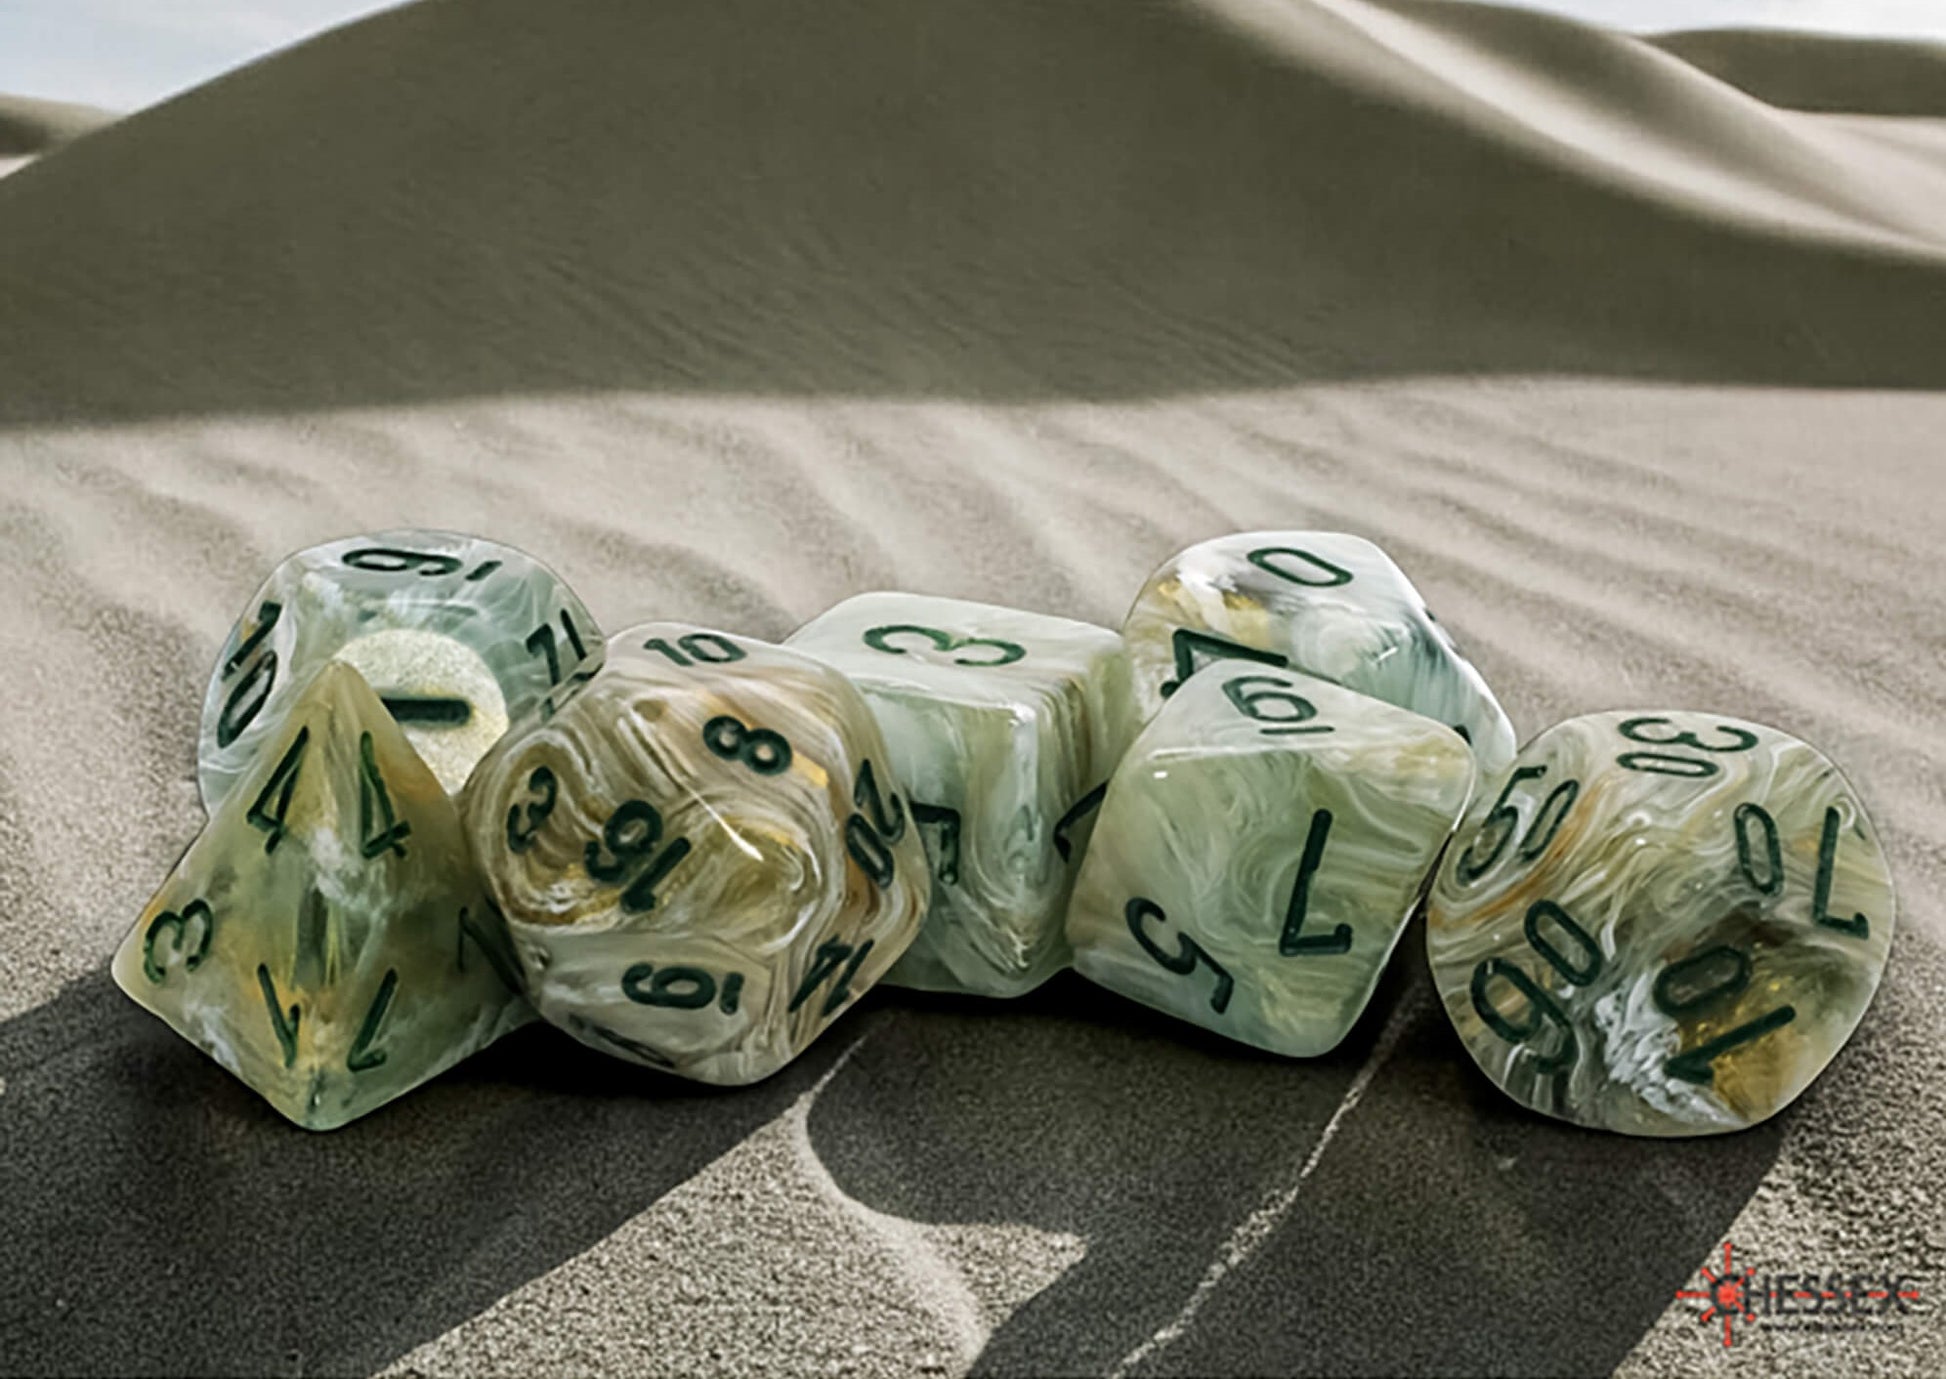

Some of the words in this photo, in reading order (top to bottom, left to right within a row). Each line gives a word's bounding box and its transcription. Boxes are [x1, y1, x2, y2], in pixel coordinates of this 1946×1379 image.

[1246, 546, 1354, 588] 0
[643, 632, 749, 666] 10
[862, 624, 1028, 667] 3
[702, 714, 793, 776] 8
[1617, 716, 1760, 778] 30
[246, 725, 310, 855] 4
[359, 730, 412, 860] 4
[1455, 764, 1580, 888] 50
[143, 898, 214, 984] 3
[1124, 896, 1235, 1014] 5
